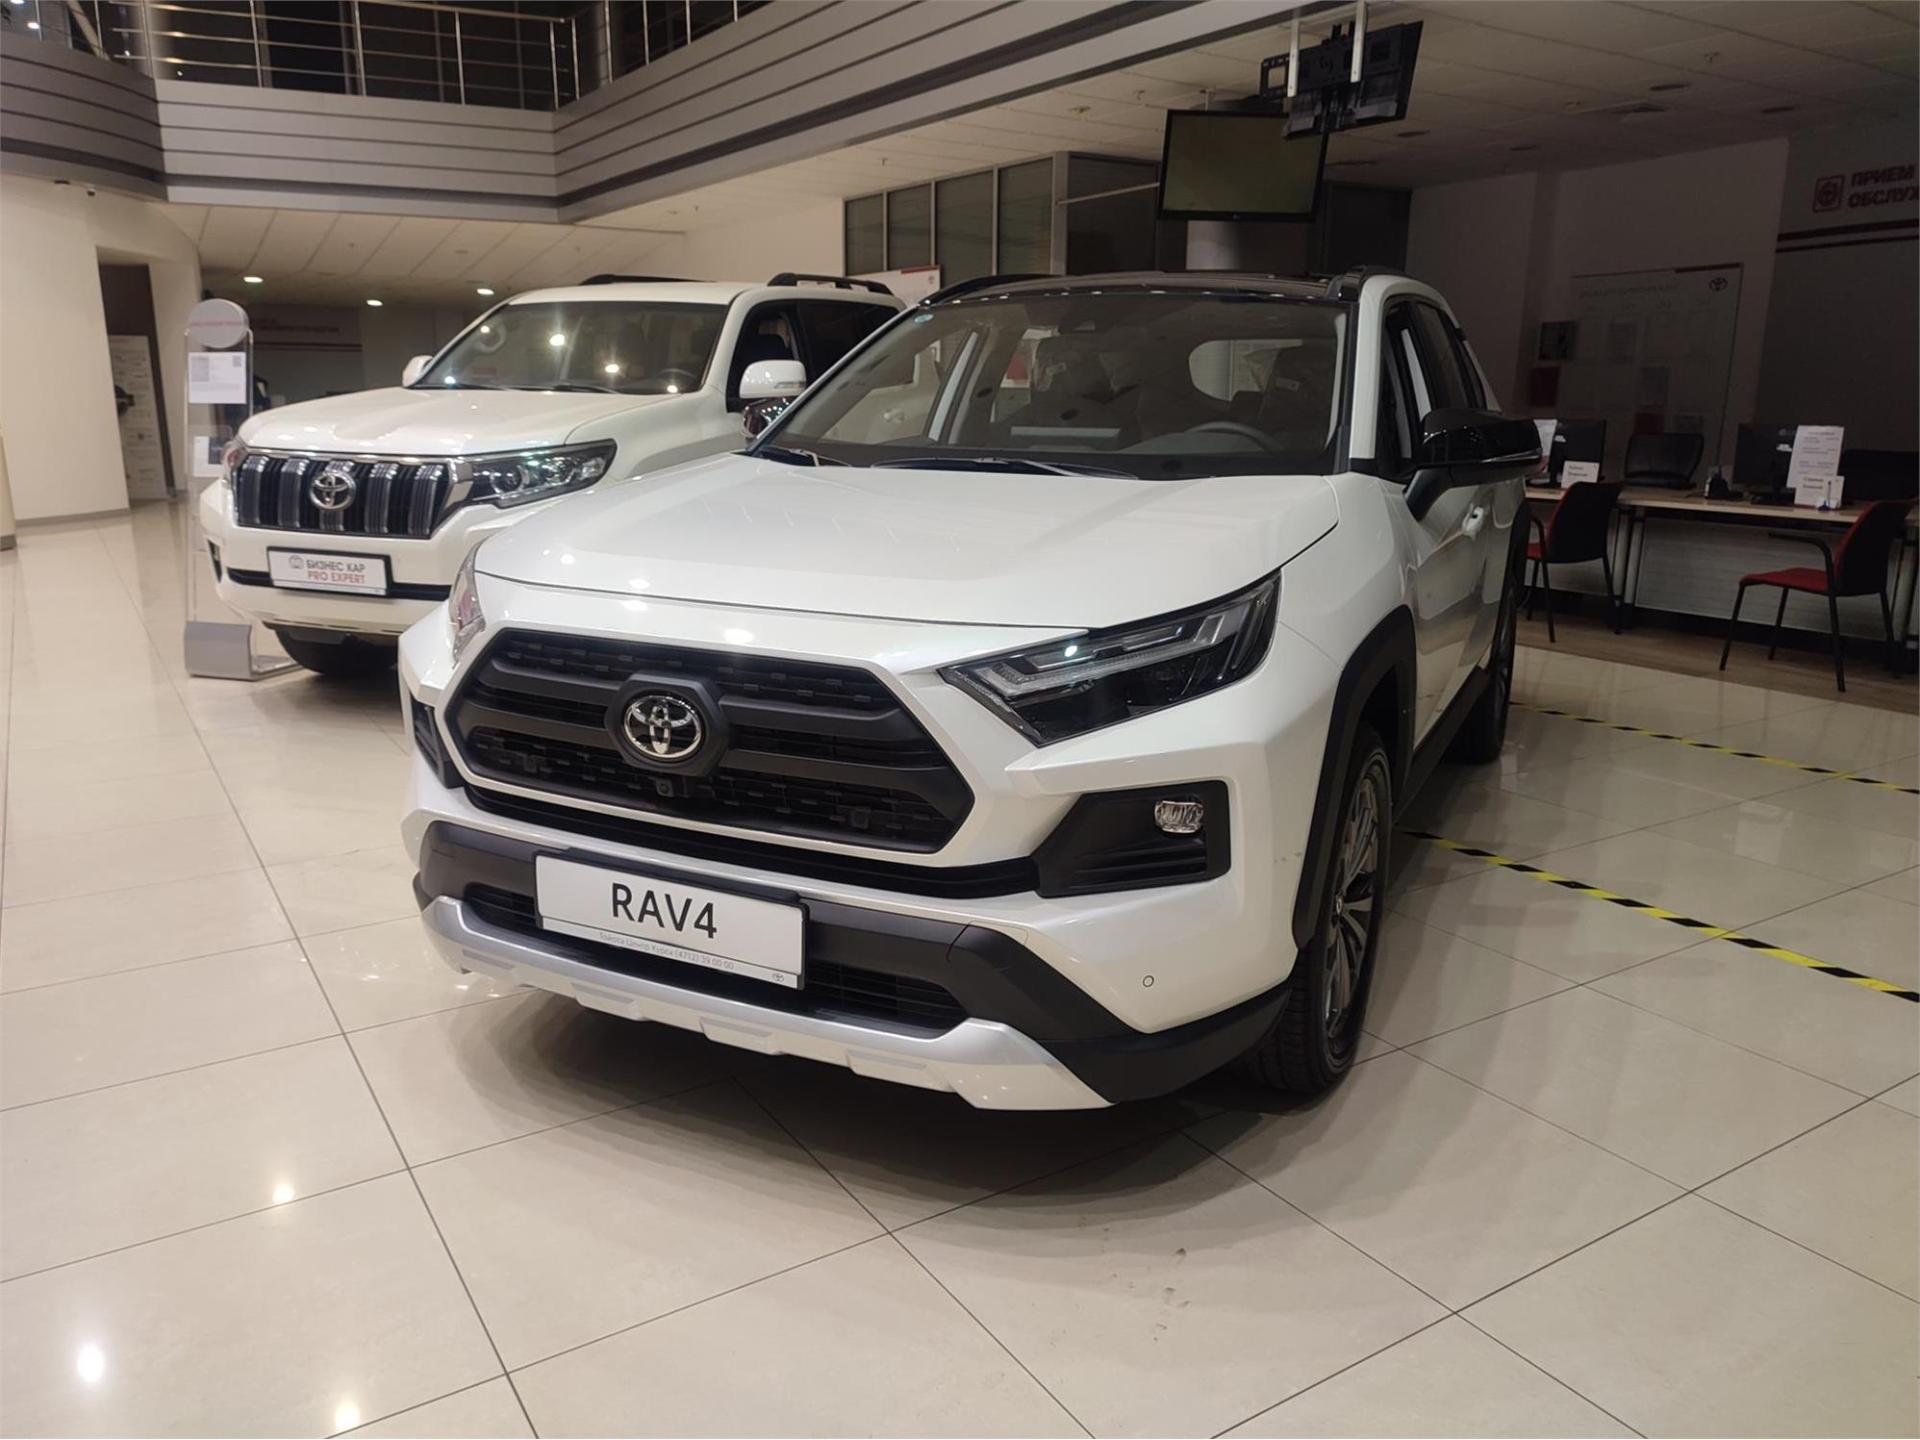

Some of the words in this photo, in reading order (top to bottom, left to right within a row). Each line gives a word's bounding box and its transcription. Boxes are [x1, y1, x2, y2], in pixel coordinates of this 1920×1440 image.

[1851, 164, 1915, 187] ПРИЕМ
[306, 560, 344, 572] БИЗНЕС
[346, 562, 366, 573] КАР
[308, 570, 329, 581] PRO
[331, 572, 366, 584] EXPERT
[612, 882, 718, 939] RAV4
